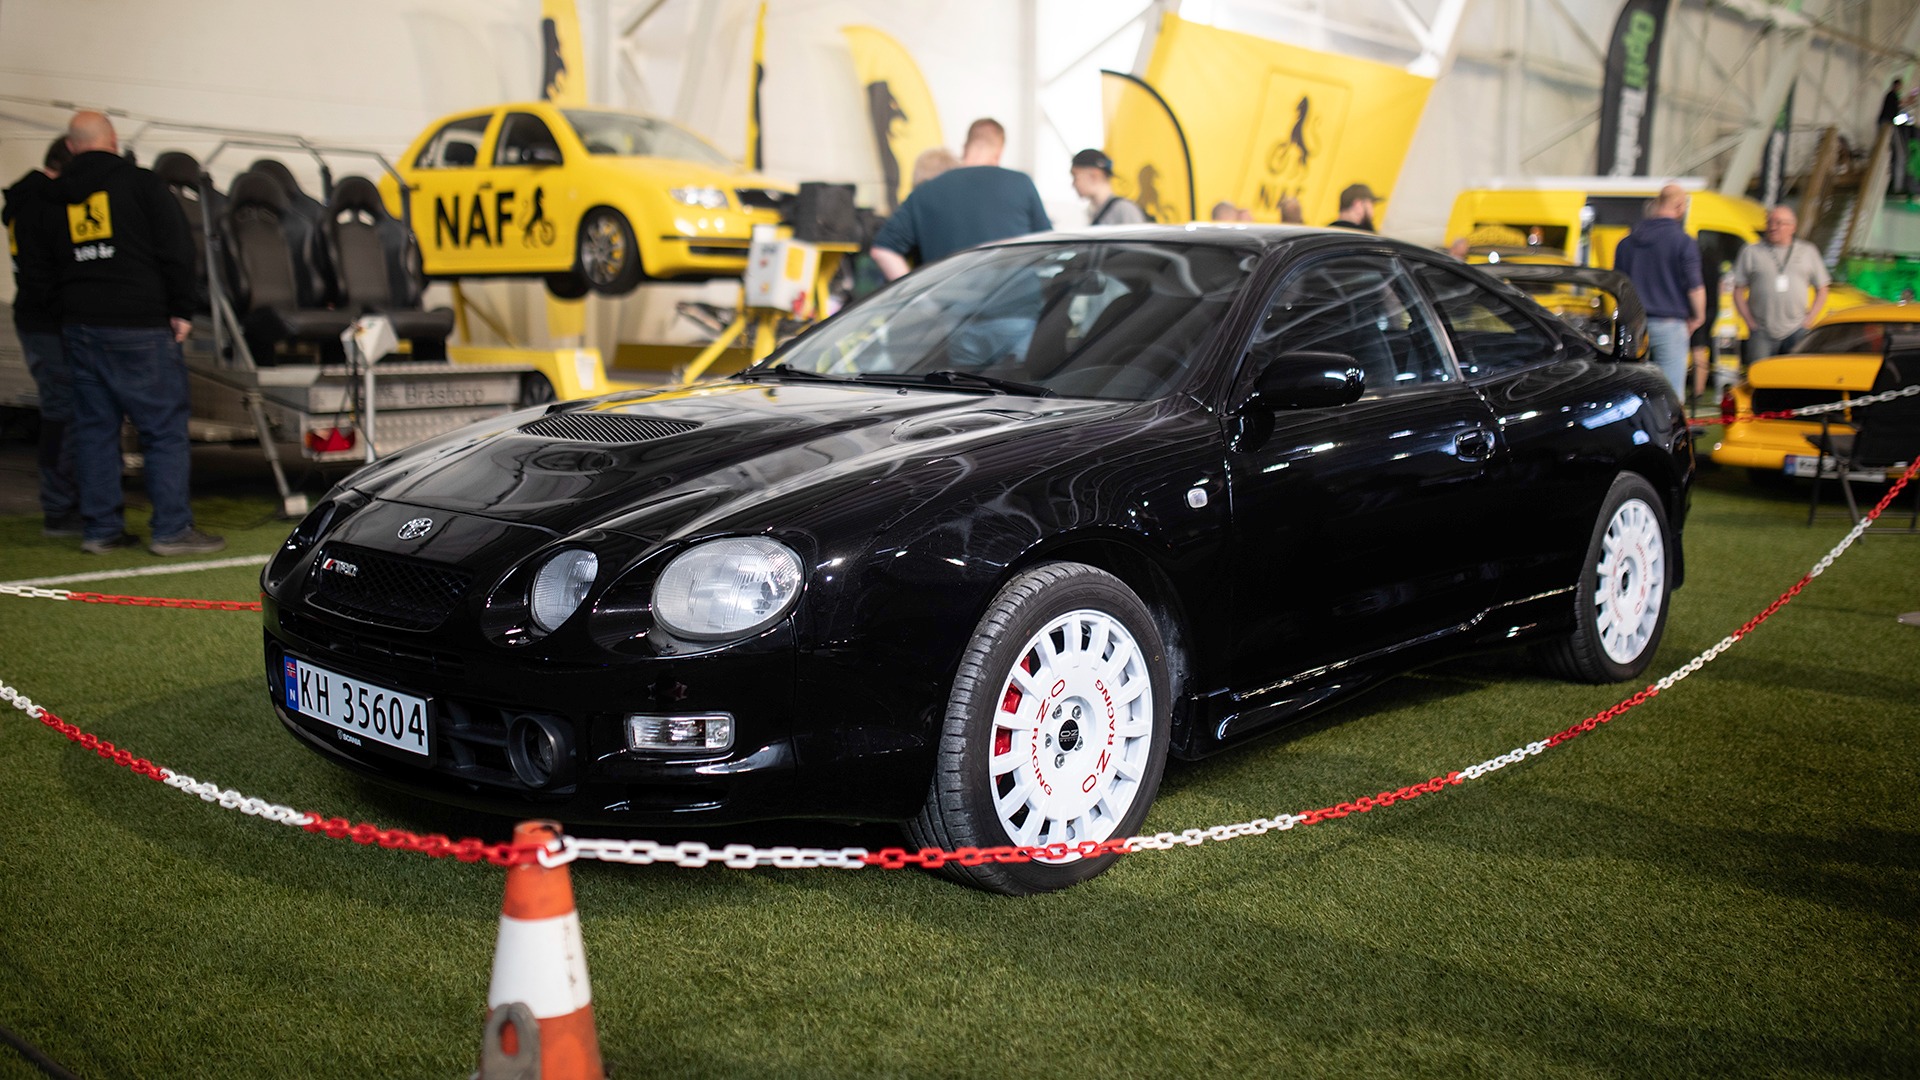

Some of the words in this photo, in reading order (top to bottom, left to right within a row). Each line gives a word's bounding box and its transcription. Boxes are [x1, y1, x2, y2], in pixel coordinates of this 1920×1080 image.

[435, 191, 514, 248] NAF
[300, 667, 330, 716] KH
[342, 682, 425, 746] 35604
[1095, 679, 1115, 745] RACING
[1032, 727, 1053, 796] RACING
